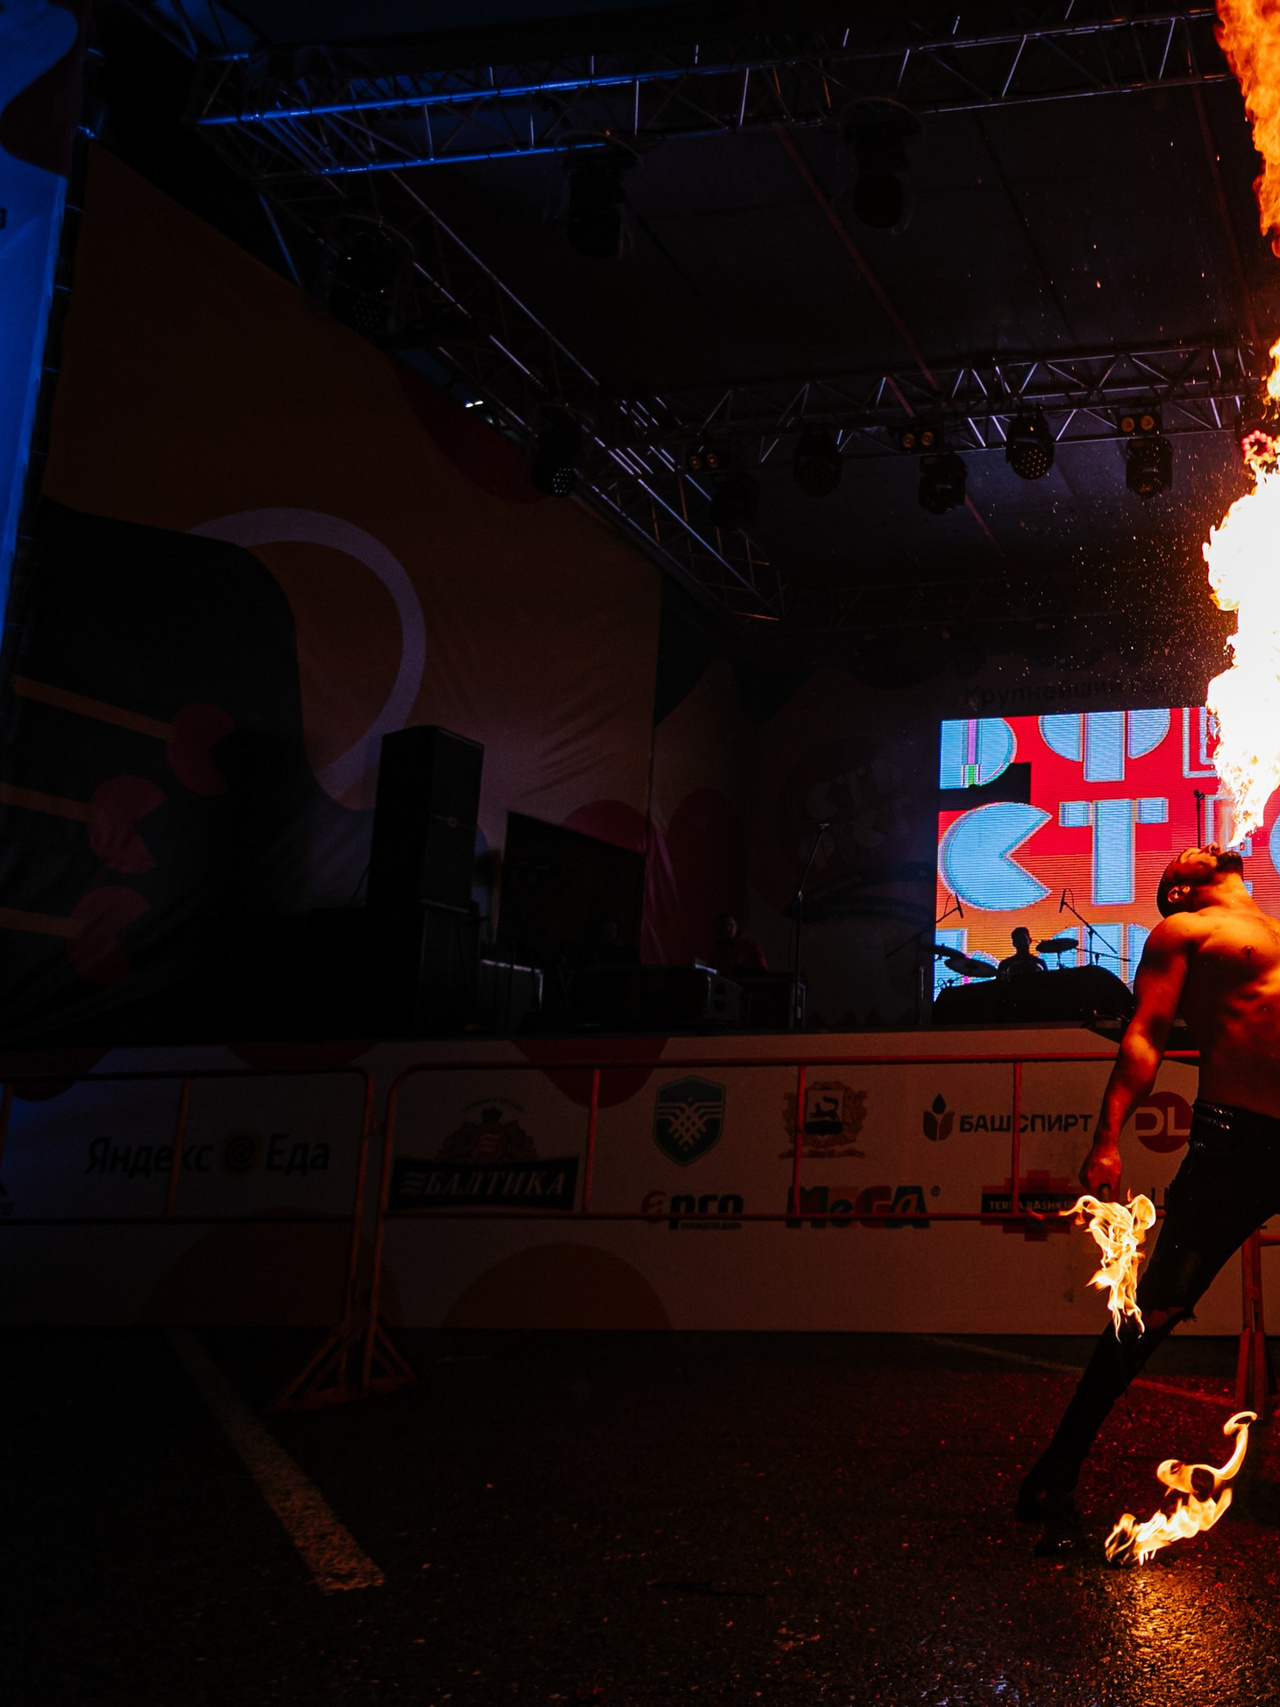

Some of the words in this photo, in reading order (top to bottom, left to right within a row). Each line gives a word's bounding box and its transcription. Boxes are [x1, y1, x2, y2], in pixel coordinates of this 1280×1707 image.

[959, 1112, 1093, 1133] БАШСПИРТ
[85, 1136, 214, 1179] Яндекс
[265, 1133, 330, 1177] Еда
[424, 1170, 567, 1196] БАЛТИКА
